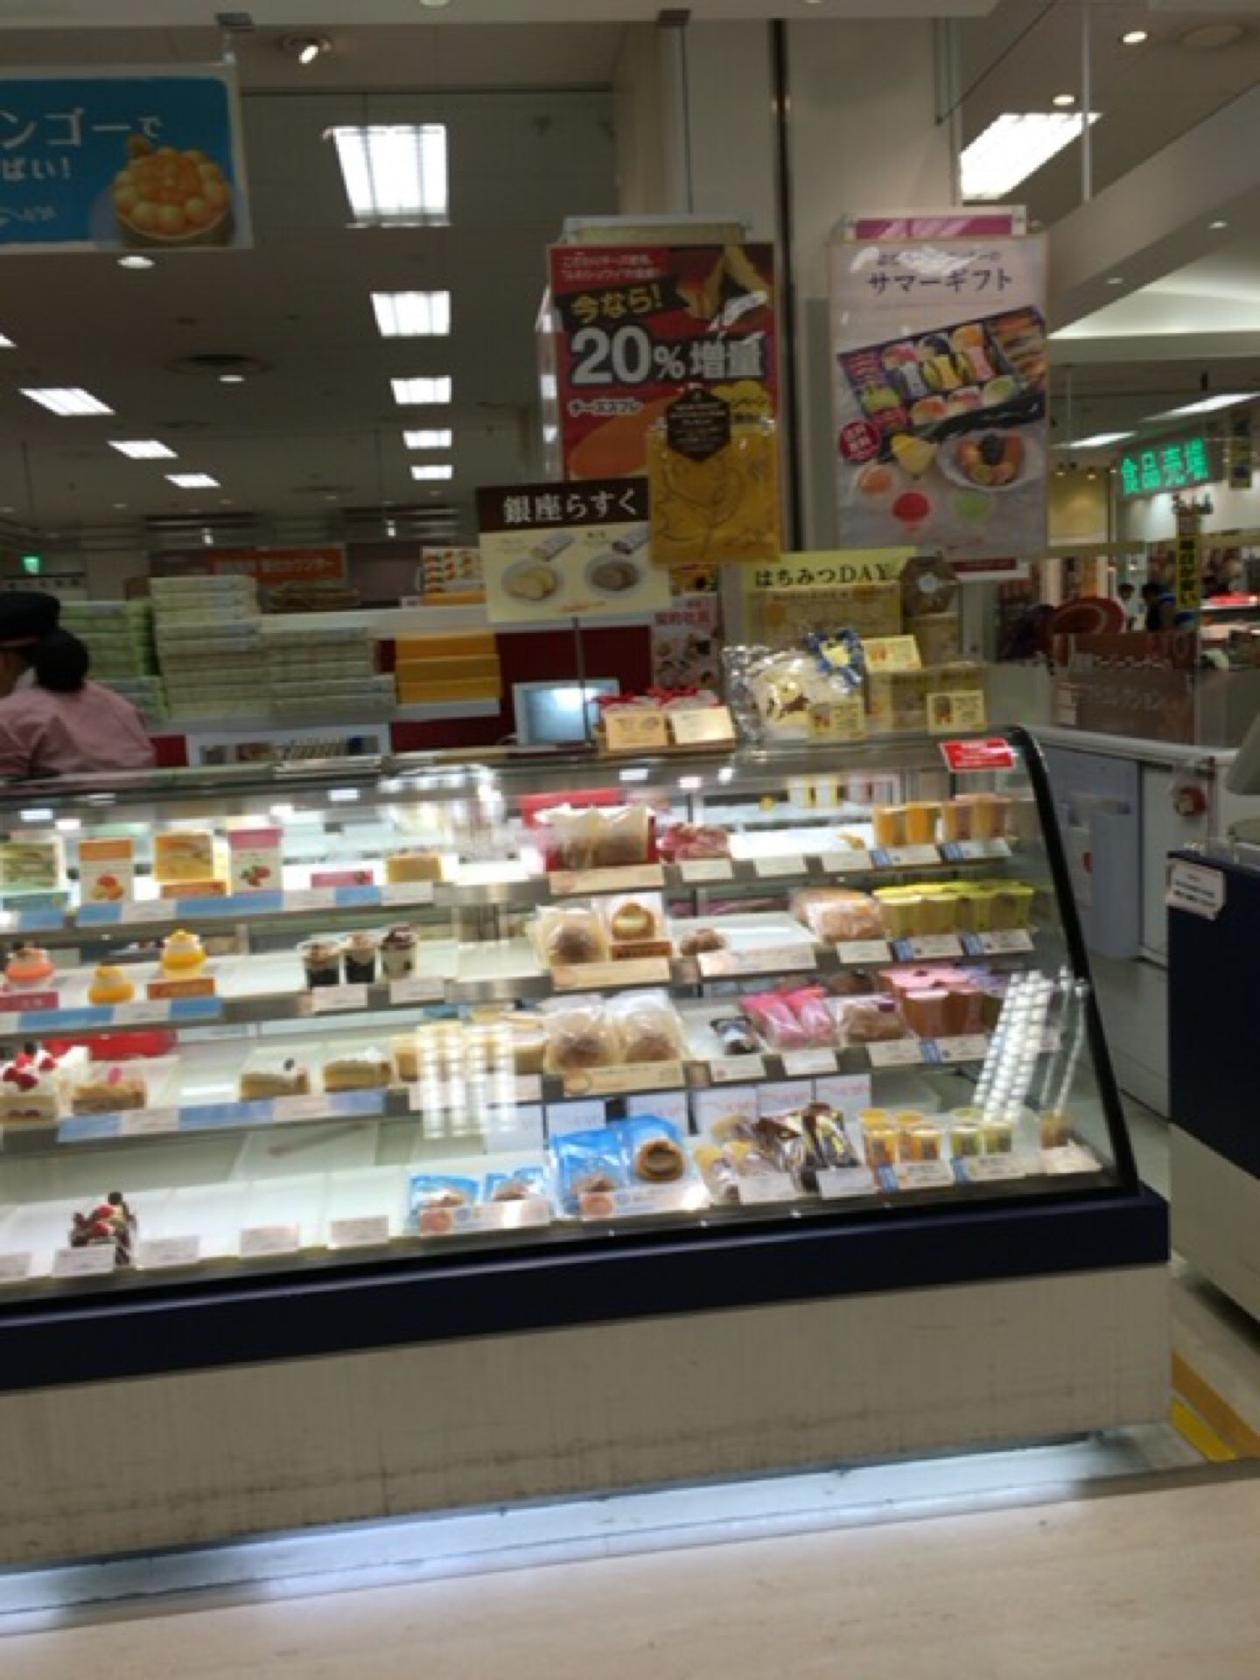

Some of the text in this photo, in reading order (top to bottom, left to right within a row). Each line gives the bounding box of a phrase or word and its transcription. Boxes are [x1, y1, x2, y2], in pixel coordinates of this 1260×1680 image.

[866, 266, 1013, 295] サマーギフト
[570, 283, 663, 324] 今なら!
[1120, 436, 1210, 496] 食品売場
[503, 487, 637, 524] 銀座らすく
[754, 563, 891, 588] はちみつDAY
